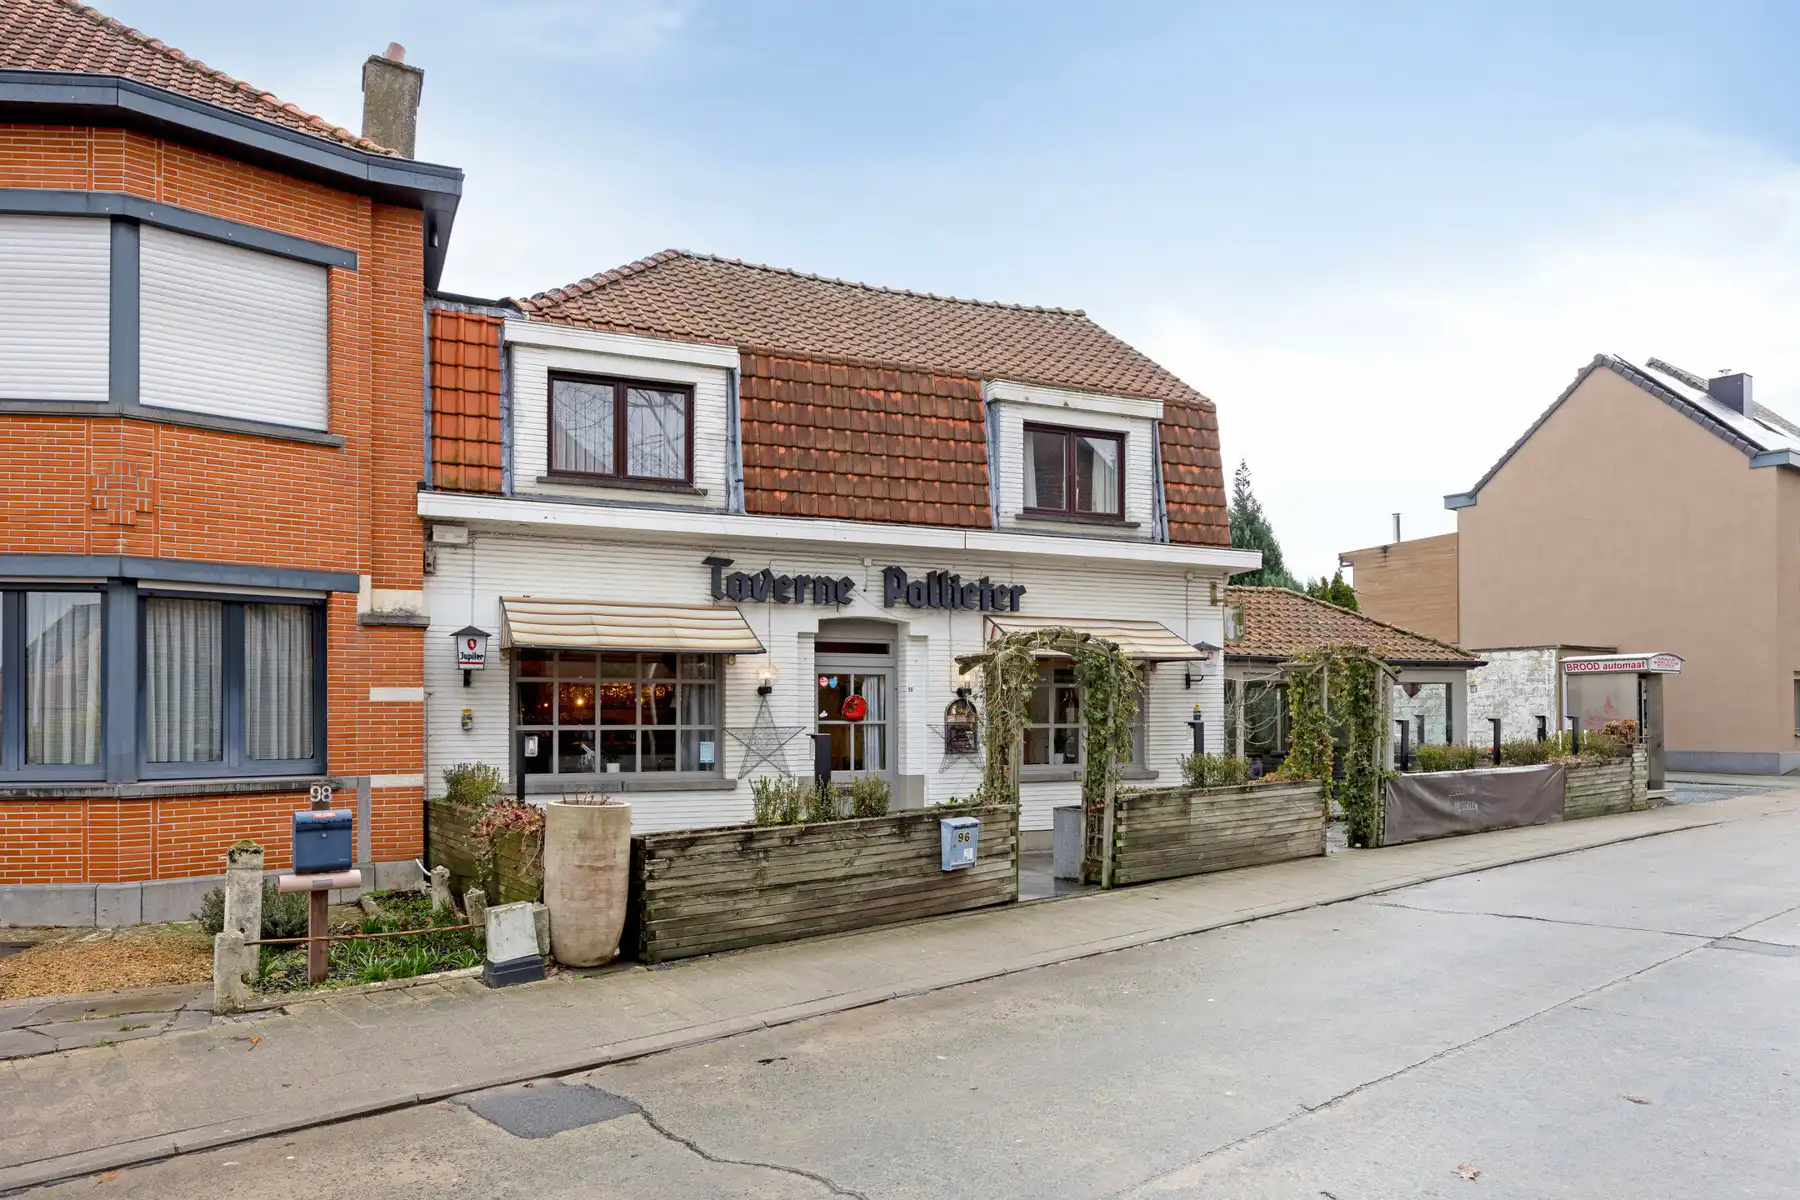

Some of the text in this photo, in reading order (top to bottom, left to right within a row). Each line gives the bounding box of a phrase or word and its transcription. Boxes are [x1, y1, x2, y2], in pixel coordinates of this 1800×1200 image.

[701, 557, 856, 605] Taverne
[460, 651, 484, 662] Jupiler
[1566, 660, 1645, 672] BROOD automaat
[310, 785, 332, 802] 98
[957, 832, 971, 843] 96
